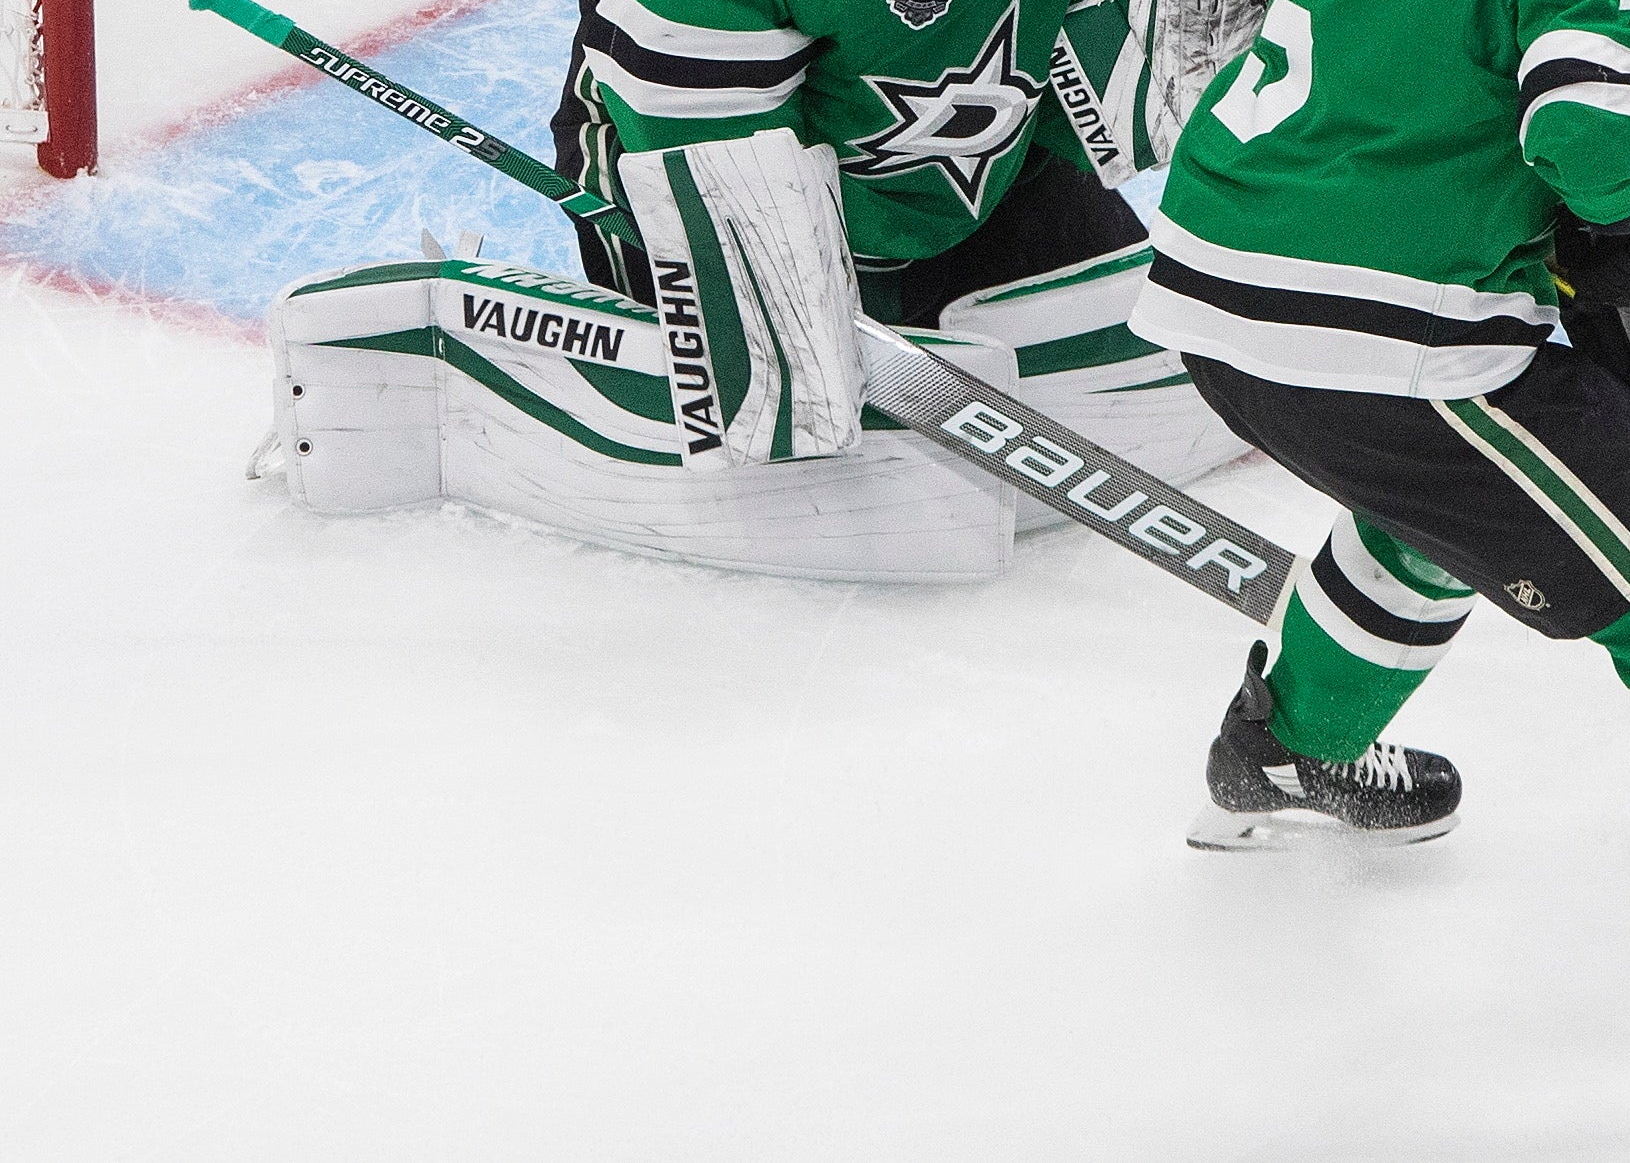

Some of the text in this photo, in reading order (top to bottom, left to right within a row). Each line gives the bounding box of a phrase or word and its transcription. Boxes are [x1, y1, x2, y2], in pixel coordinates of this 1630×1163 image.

[1050, 46, 1120, 167] VAUGHN
[463, 294, 625, 362] VAUGHN
[655, 260, 722, 455] VAUGHN
